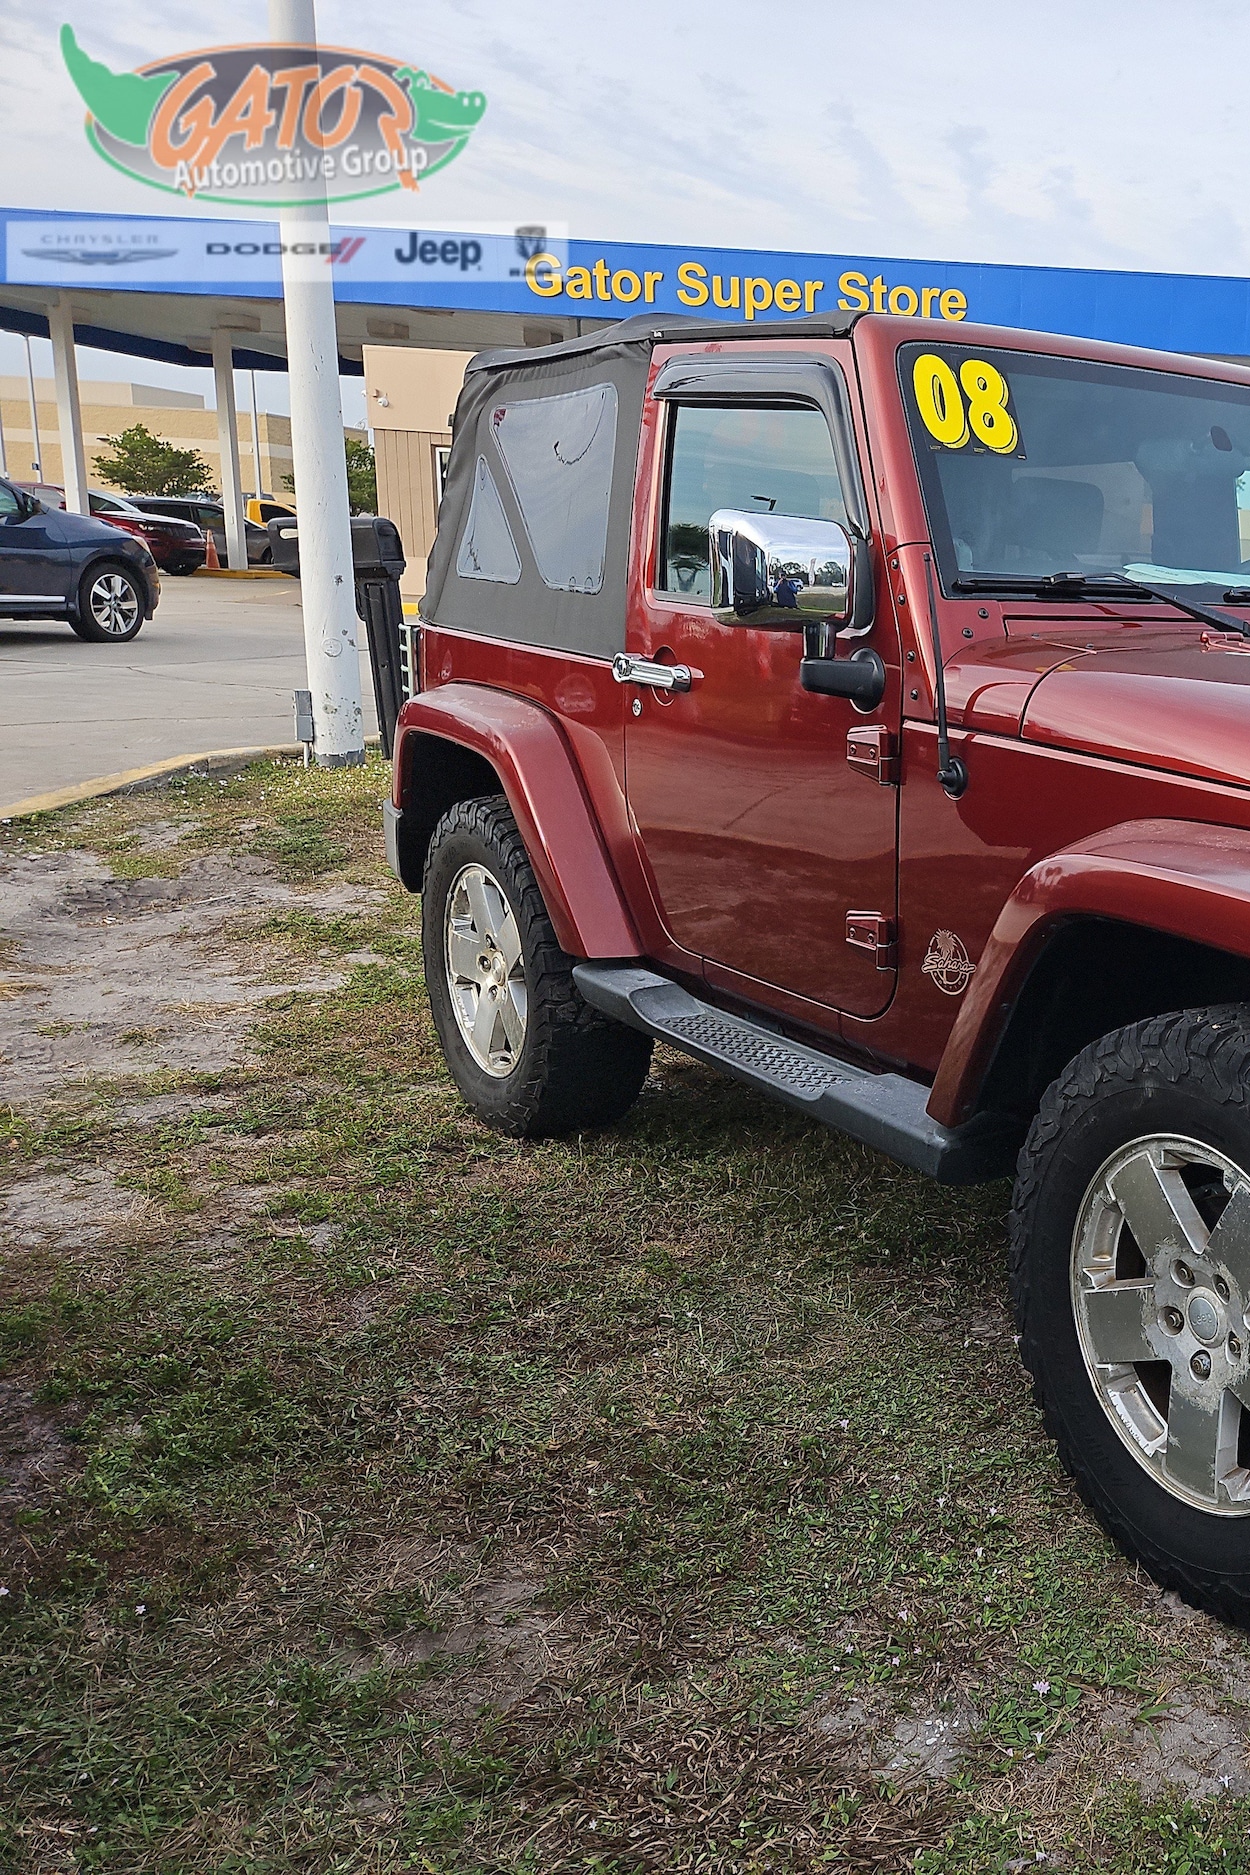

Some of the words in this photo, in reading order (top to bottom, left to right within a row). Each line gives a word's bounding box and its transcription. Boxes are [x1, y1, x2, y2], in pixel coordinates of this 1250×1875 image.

[524, 252, 664, 302] Gator
[676, 261, 825, 321] Super
[837, 271, 968, 321] Store
[912, 353, 1019, 456] 08
[921, 952, 977, 973] Sahara
